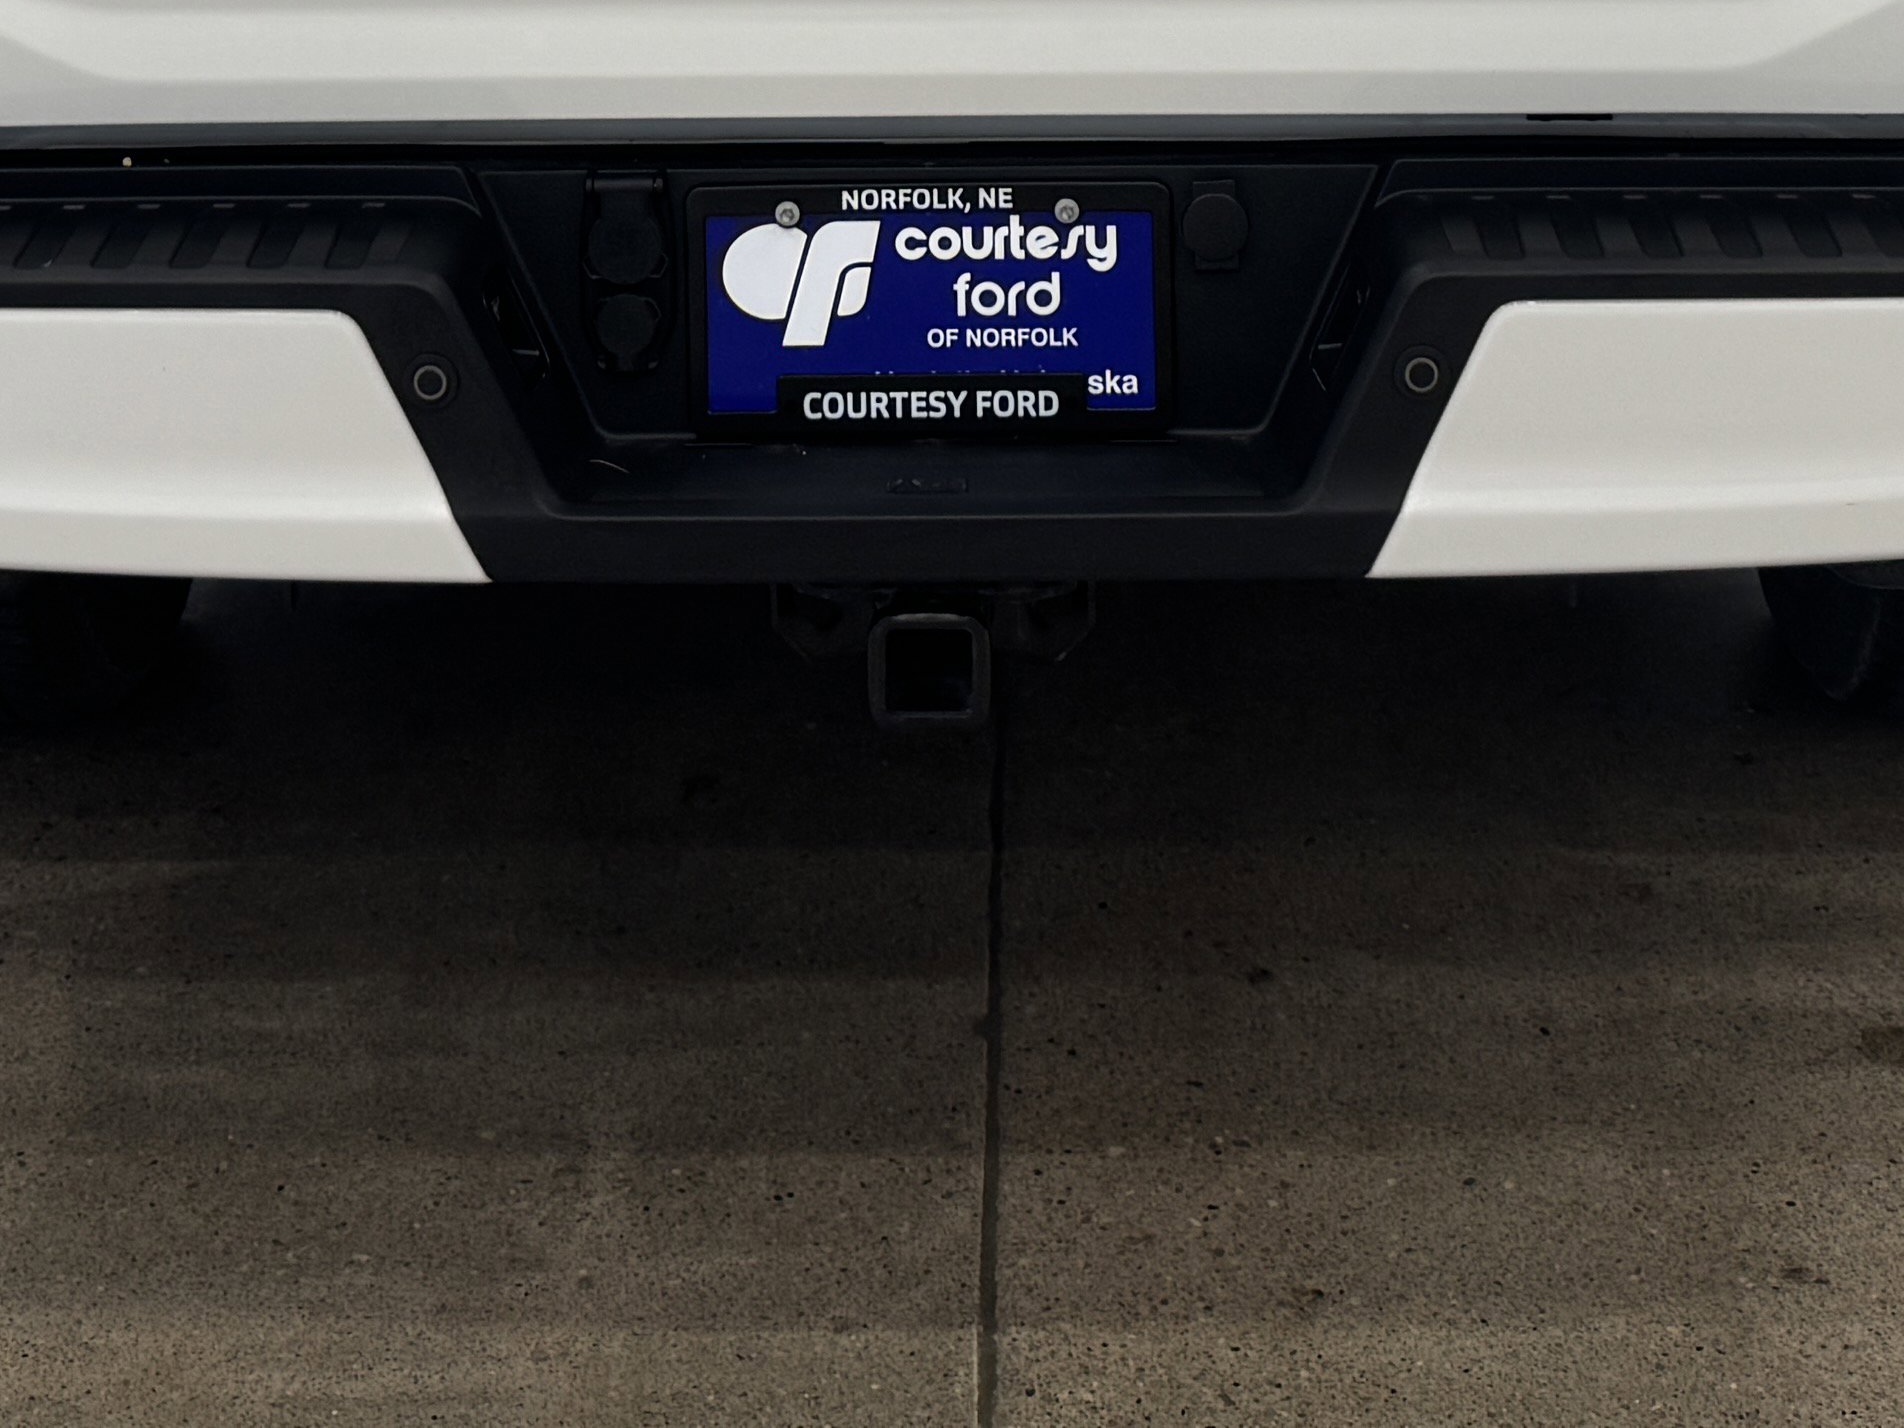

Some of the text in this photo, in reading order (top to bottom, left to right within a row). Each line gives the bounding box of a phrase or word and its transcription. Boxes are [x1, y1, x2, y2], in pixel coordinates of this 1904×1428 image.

[841, 187, 1014, 214] NORFOLK, NE
[895, 215, 1118, 273] courtesy
[953, 272, 1061, 318] ford
[927, 327, 1079, 348] OF NORFOLK
[803, 389, 1060, 420] COURTESY FORD
